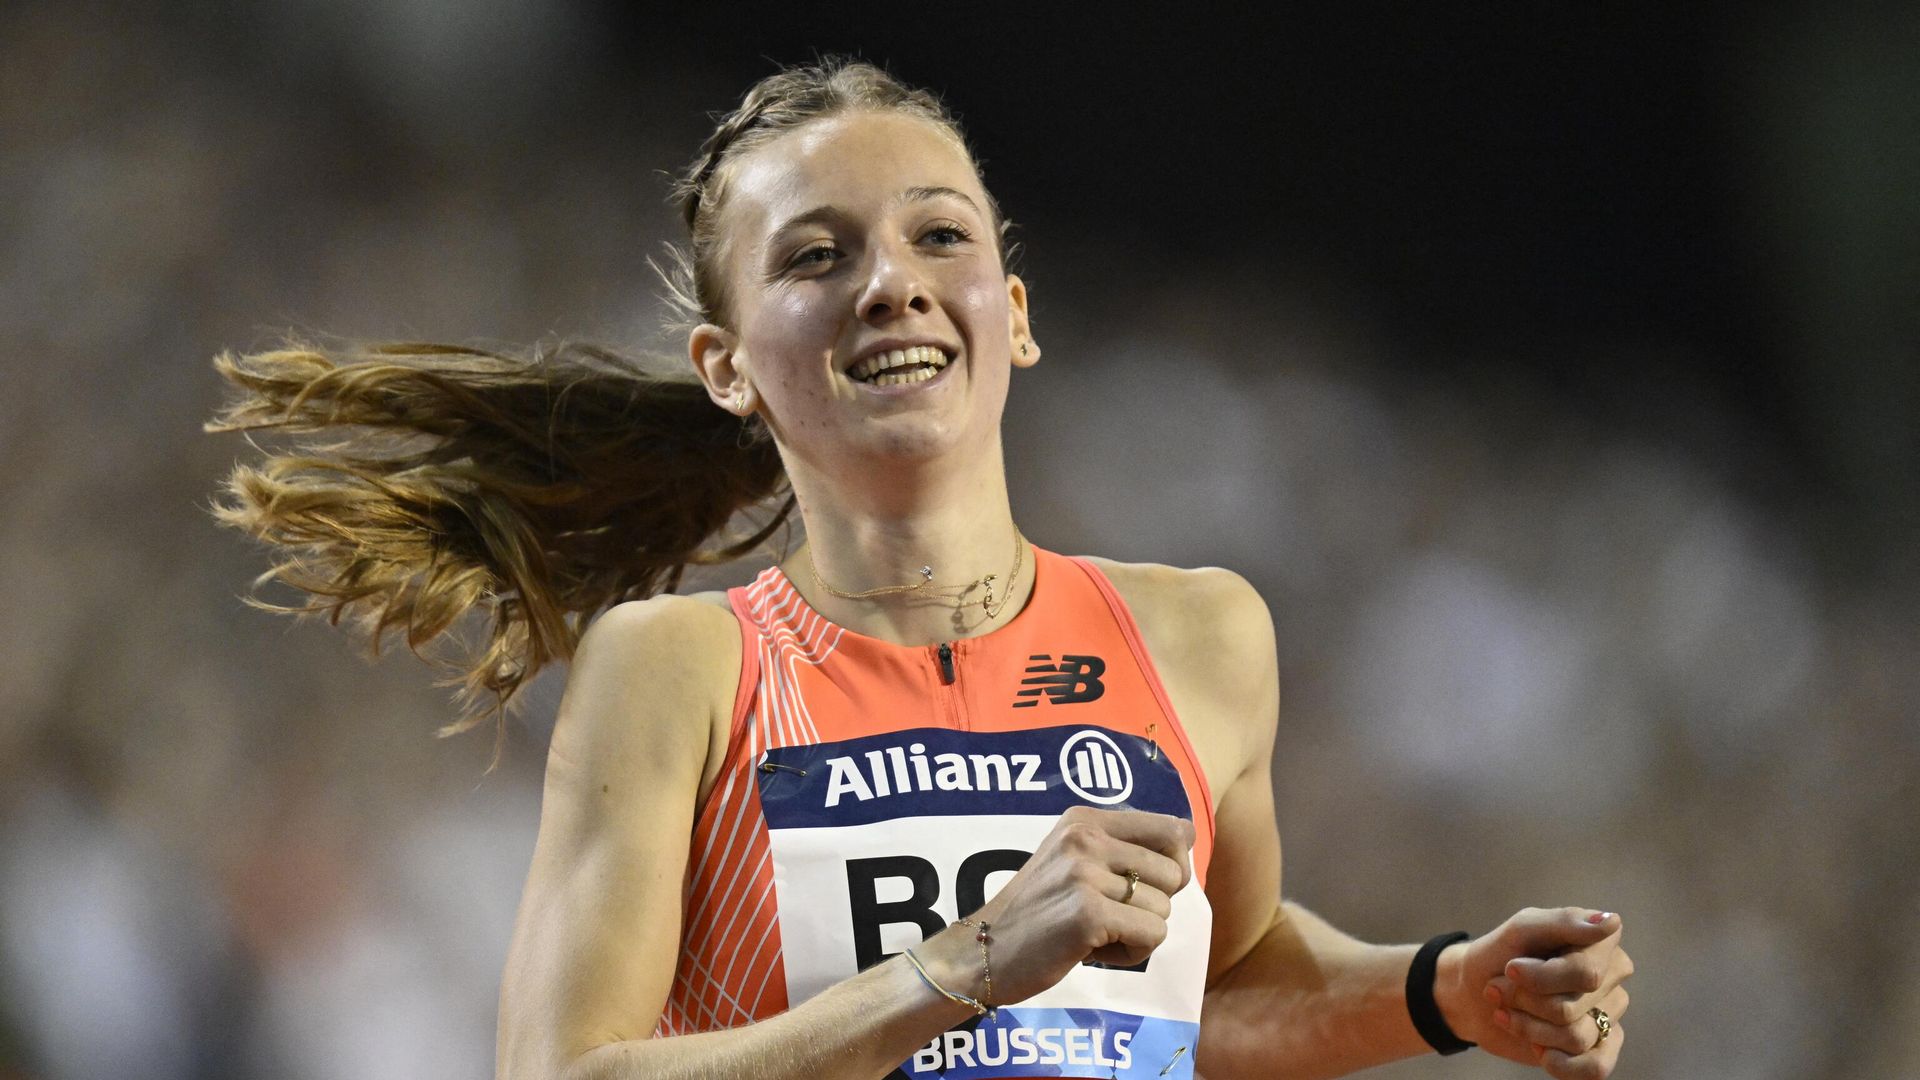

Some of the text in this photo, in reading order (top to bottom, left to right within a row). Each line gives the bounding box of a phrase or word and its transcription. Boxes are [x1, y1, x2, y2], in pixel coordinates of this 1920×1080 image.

[1012, 654, 1106, 708] NB
[824, 743, 1047, 807] Allianz
[913, 1027, 1132, 1073] BRUSSELS
